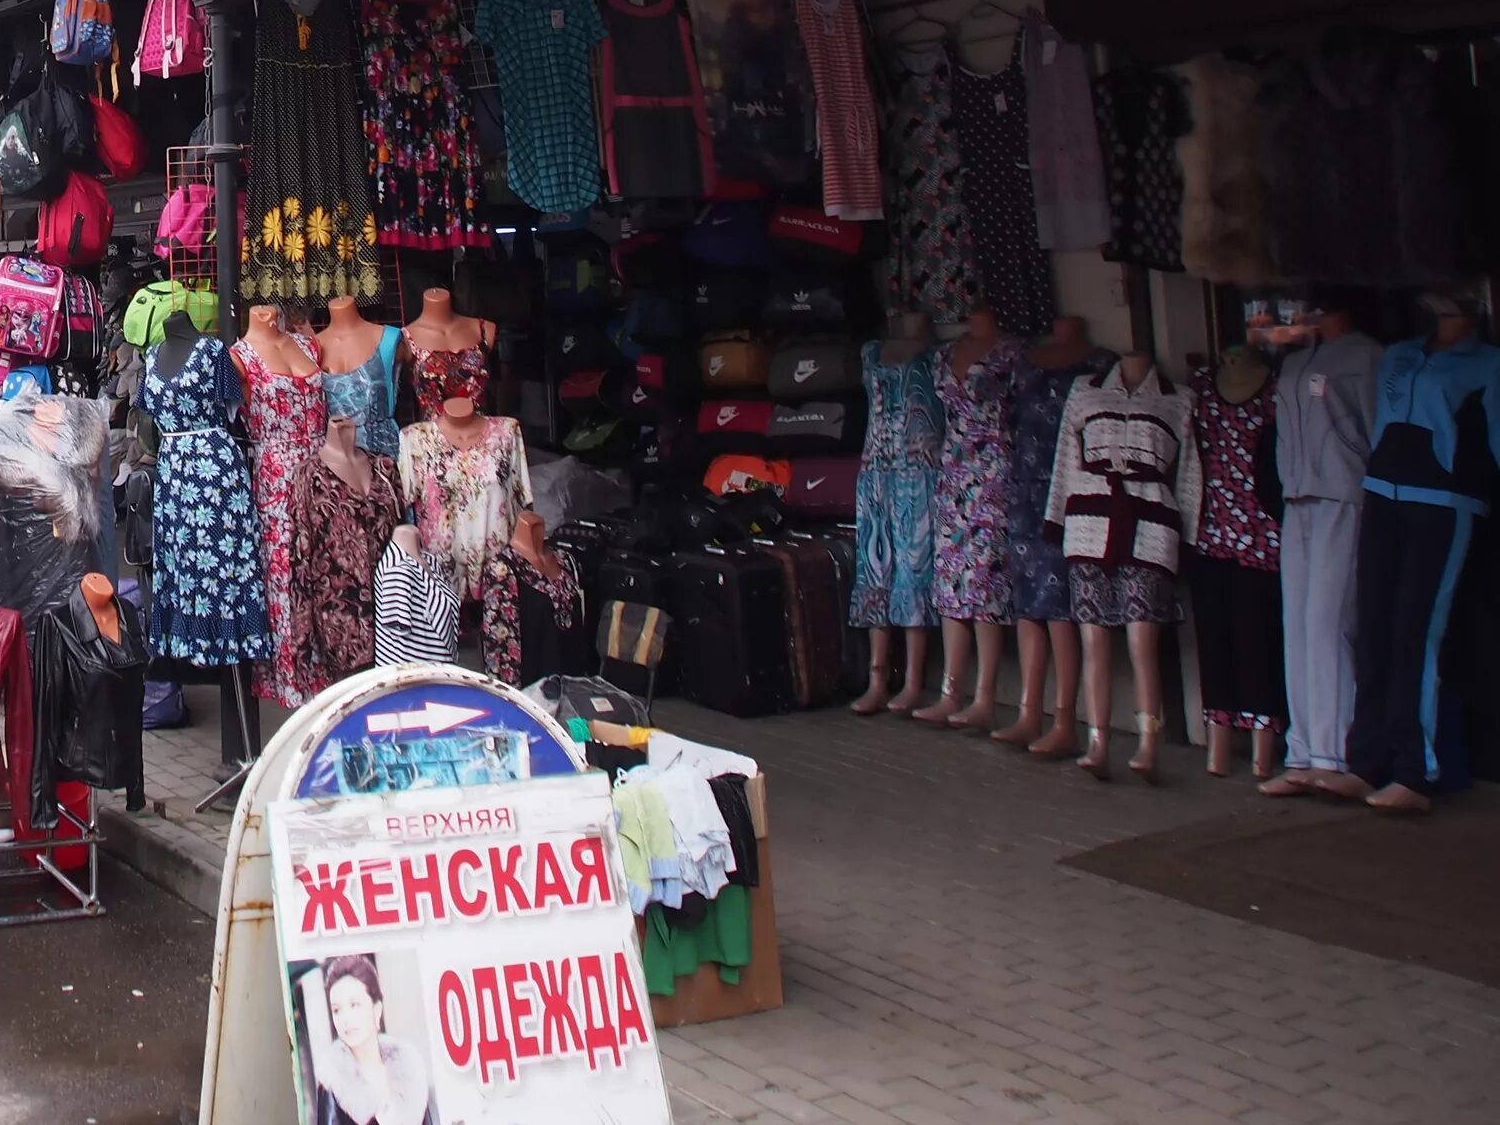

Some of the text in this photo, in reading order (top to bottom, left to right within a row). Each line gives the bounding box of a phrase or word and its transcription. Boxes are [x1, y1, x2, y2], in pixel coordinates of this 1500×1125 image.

[386, 807, 512, 838] ВЕРХНЯЯ
[295, 837, 611, 932] ЖЕНСКАЯ
[438, 952, 648, 1083] ОДЕЖДА
